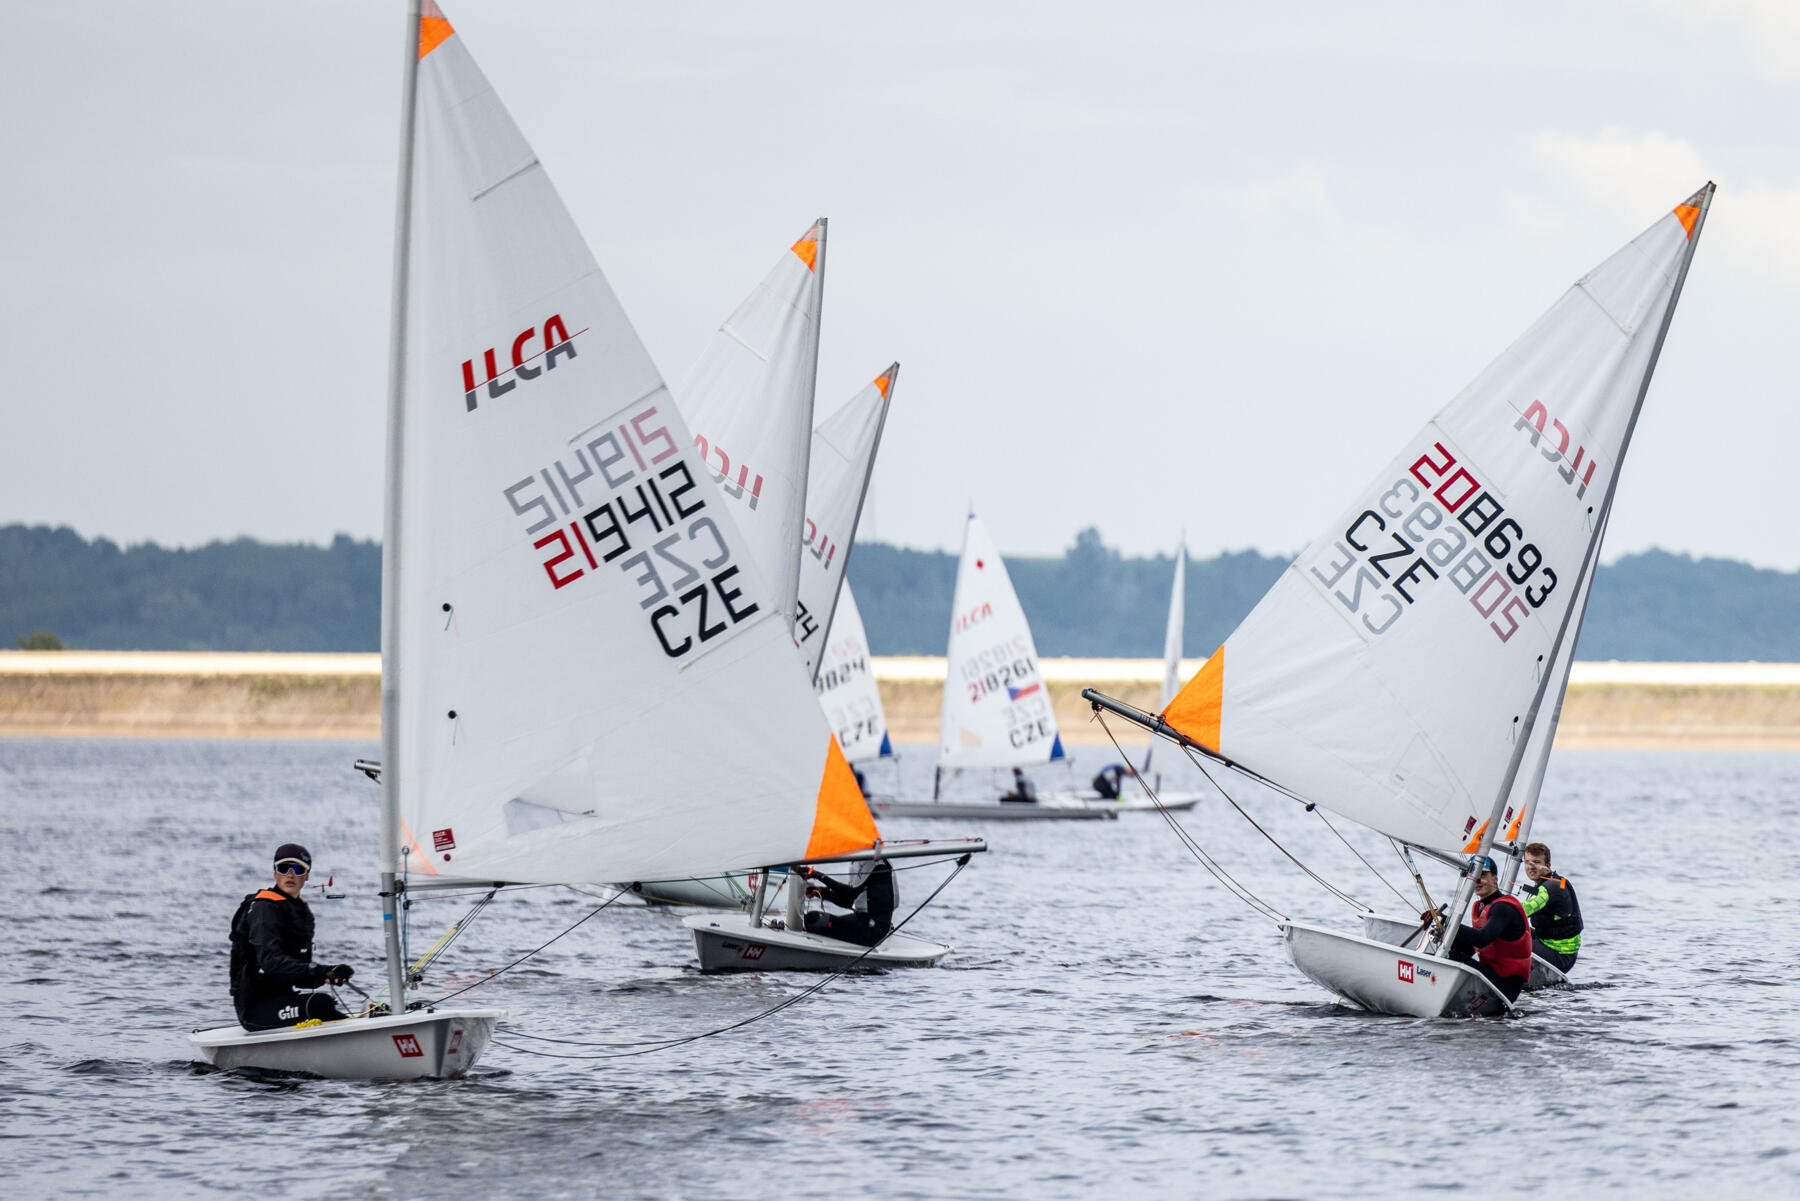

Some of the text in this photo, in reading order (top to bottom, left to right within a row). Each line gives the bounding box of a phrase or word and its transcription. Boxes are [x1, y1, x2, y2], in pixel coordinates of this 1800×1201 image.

[462, 313, 579, 413] ILCA
[533, 460, 706, 590] 219412
[1408, 442, 1558, 608] 208693
[1345, 510, 1439, 605] CZE
[650, 565, 760, 658] CZE
[956, 602, 992, 634] ILCA
[839, 715, 880, 749] CZE
[1010, 716, 1052, 749] CZE
[1399, 963, 1412, 981] HH
[1416, 965, 1432, 977] Laser
[279, 1005, 299, 1020] Gill
[396, 1038, 420, 1054] HH
